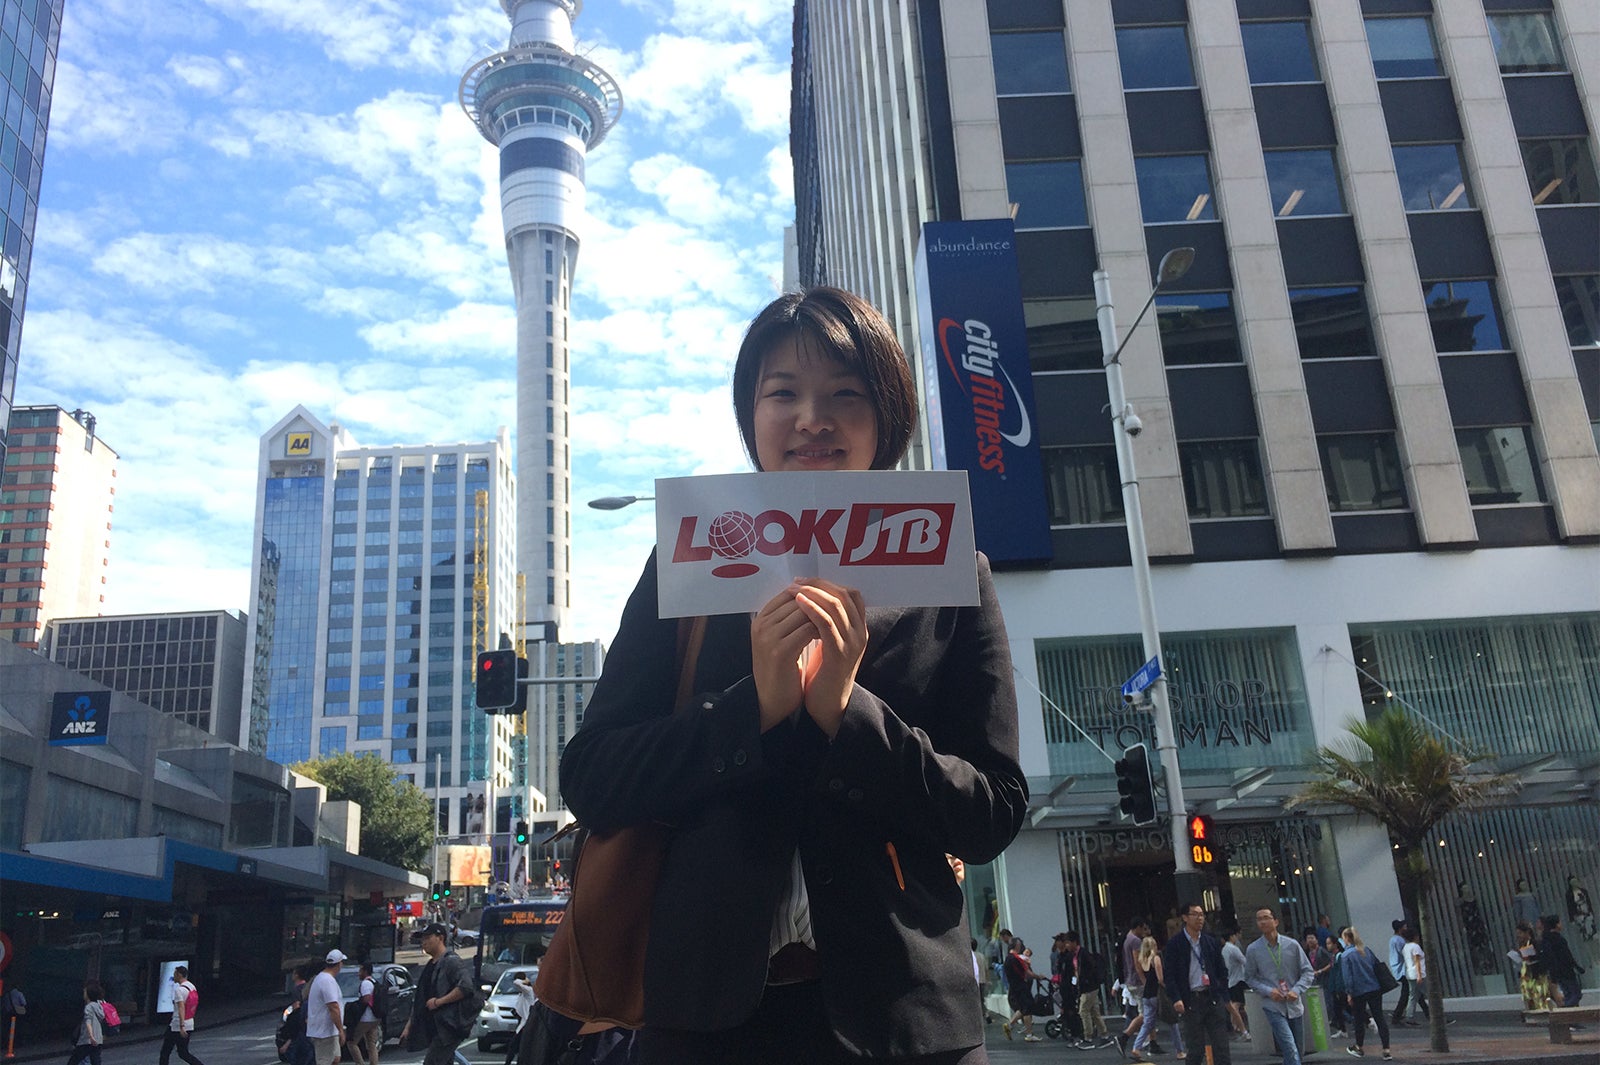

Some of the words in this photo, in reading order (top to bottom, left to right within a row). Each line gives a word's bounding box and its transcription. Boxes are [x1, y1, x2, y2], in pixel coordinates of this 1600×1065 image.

[929, 236, 1010, 253] abundance
[290, 437, 310, 450] AA
[671, 508, 847, 564] LOOK
[849, 507, 942, 562] JTB
[62, 721, 97, 734] ANZ
[1192, 845, 1213, 863] 06
[103, 910, 120, 919] ANZ
